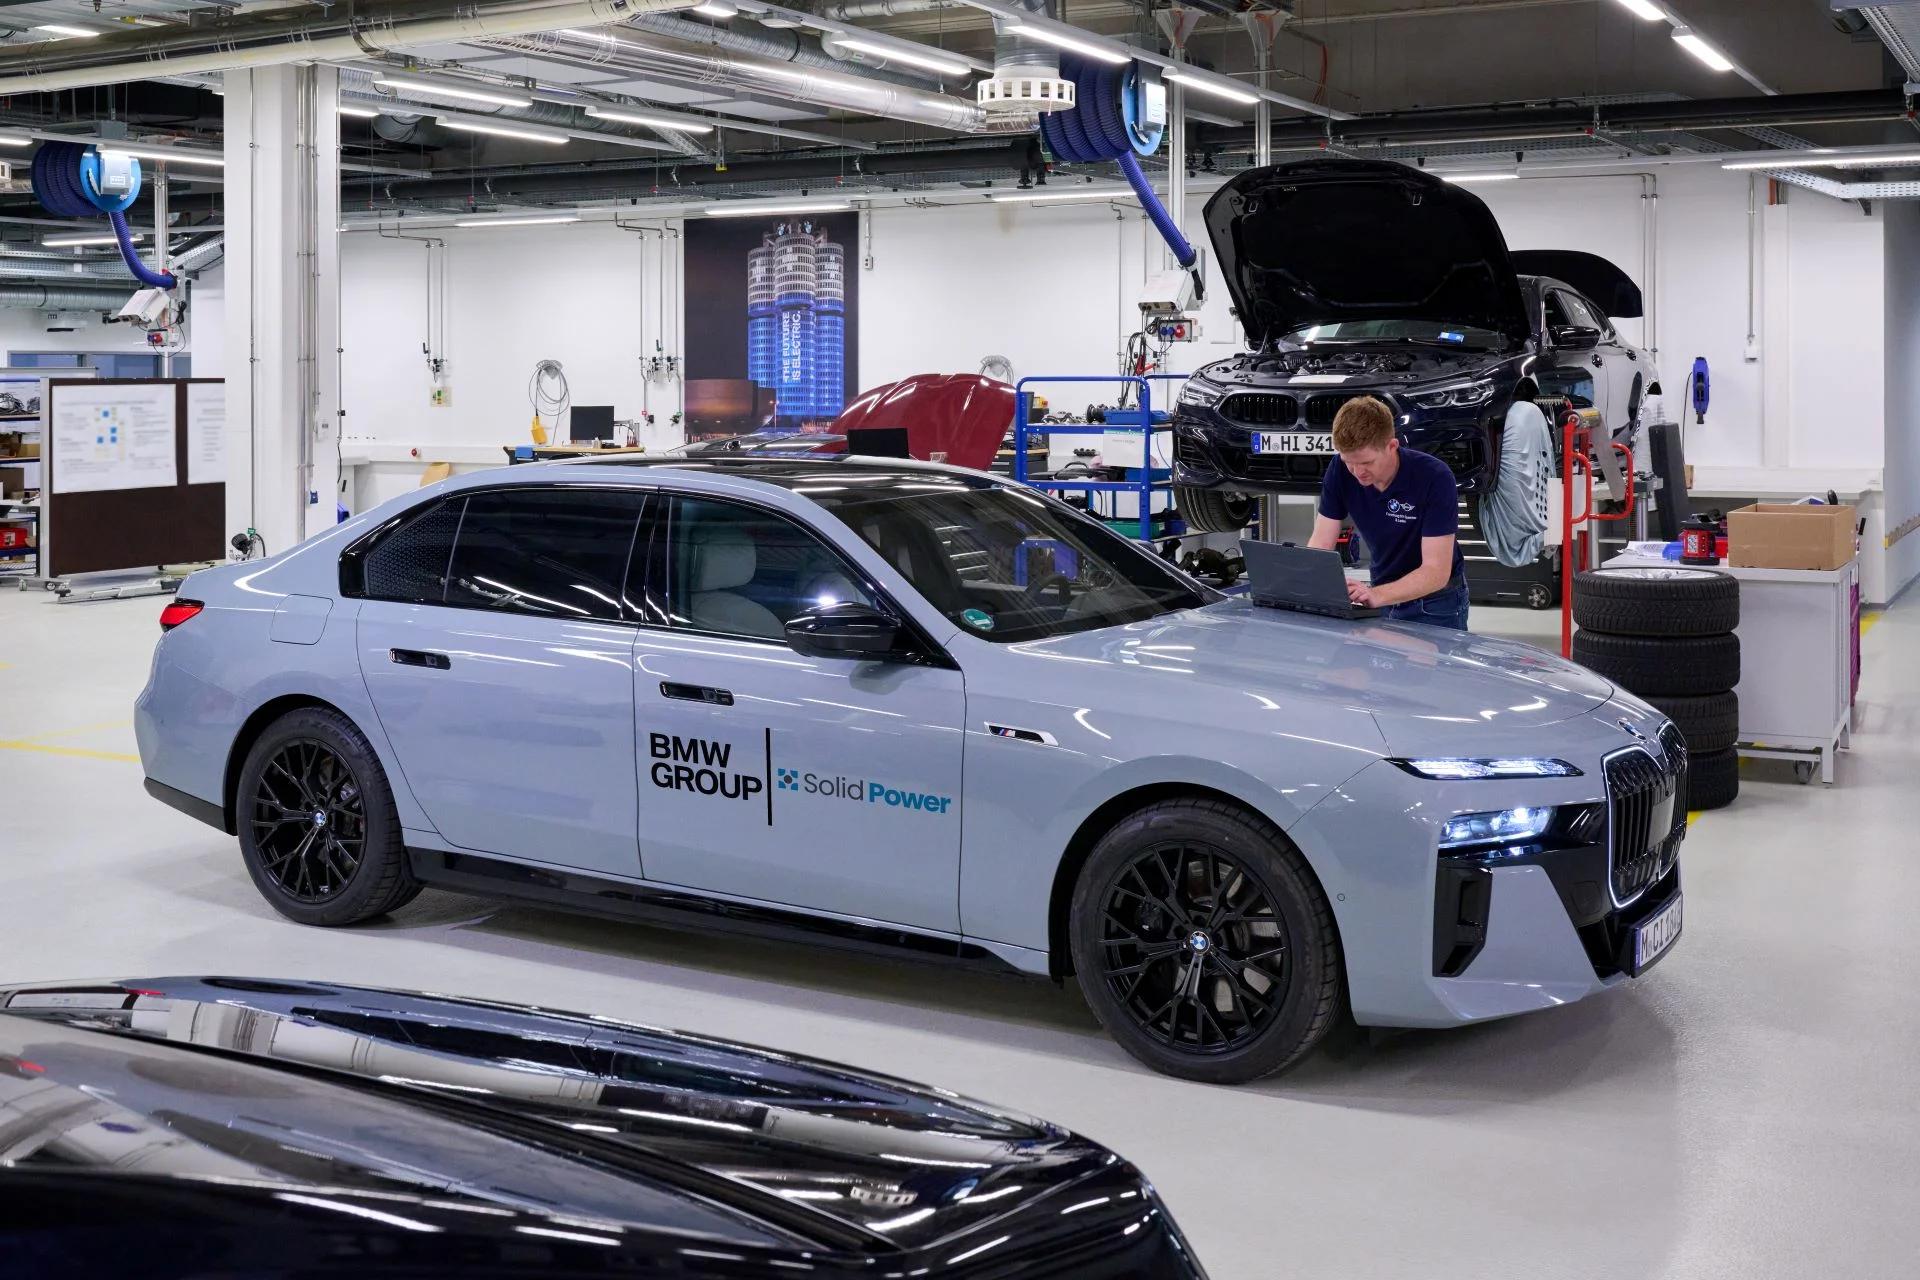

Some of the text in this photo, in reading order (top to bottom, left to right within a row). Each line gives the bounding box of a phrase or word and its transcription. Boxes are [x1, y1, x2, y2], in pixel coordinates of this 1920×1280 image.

[782, 311, 790, 384] THE FUTURE
[792, 310, 801, 381] IS ELECTRIC.
[1261, 435, 1271, 451] M
[1280, 435, 1300, 452] HI
[650, 732, 731, 768] BMW
[651, 762, 762, 800] GROUP
[804, 773, 951, 814] Solid Power
[1641, 929, 1649, 961] M
